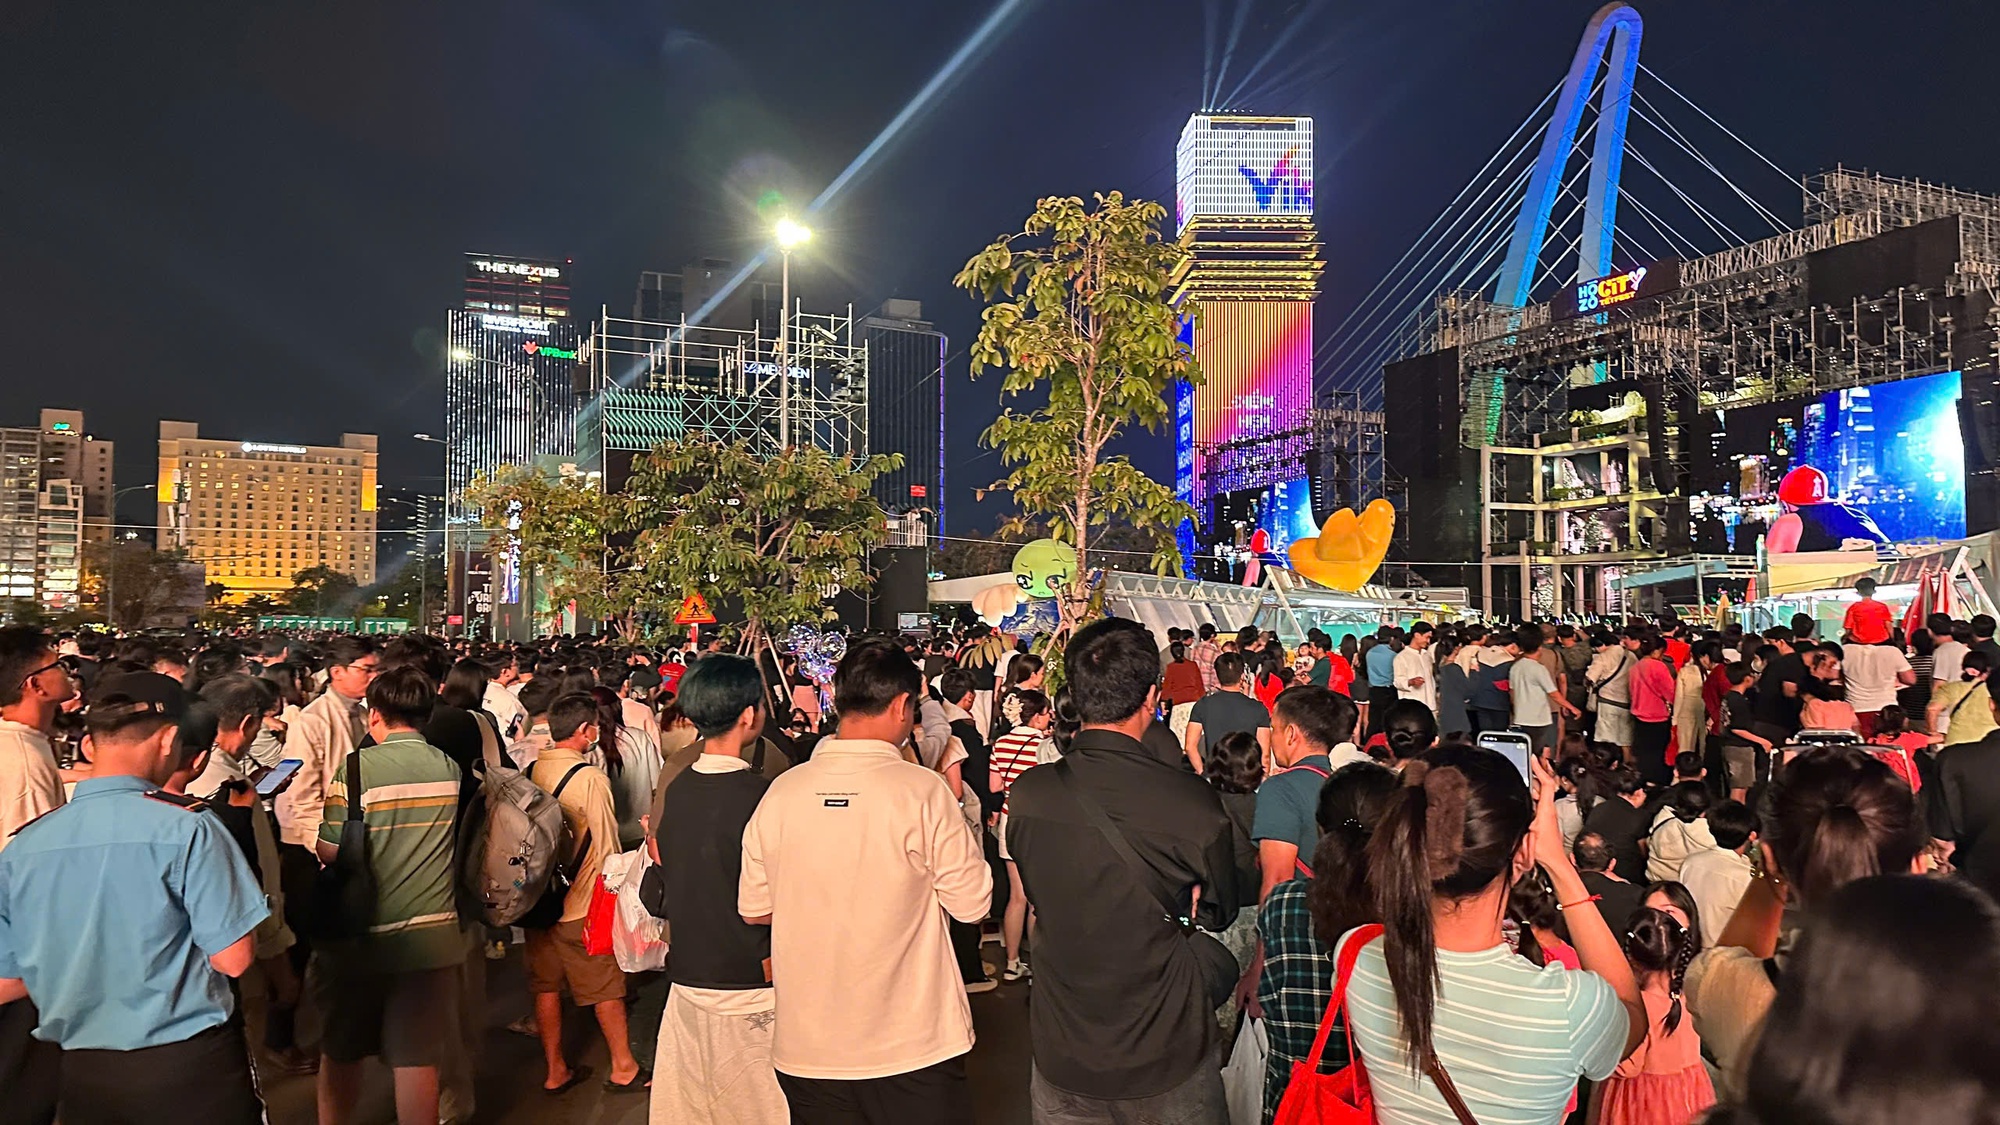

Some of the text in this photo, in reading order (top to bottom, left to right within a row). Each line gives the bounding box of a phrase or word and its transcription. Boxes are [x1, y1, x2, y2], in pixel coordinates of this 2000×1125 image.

[476, 261, 560, 278] THE NEXUS
[539, 346, 578, 359] VPBank
[759, 364, 810, 379] MEDIEN
